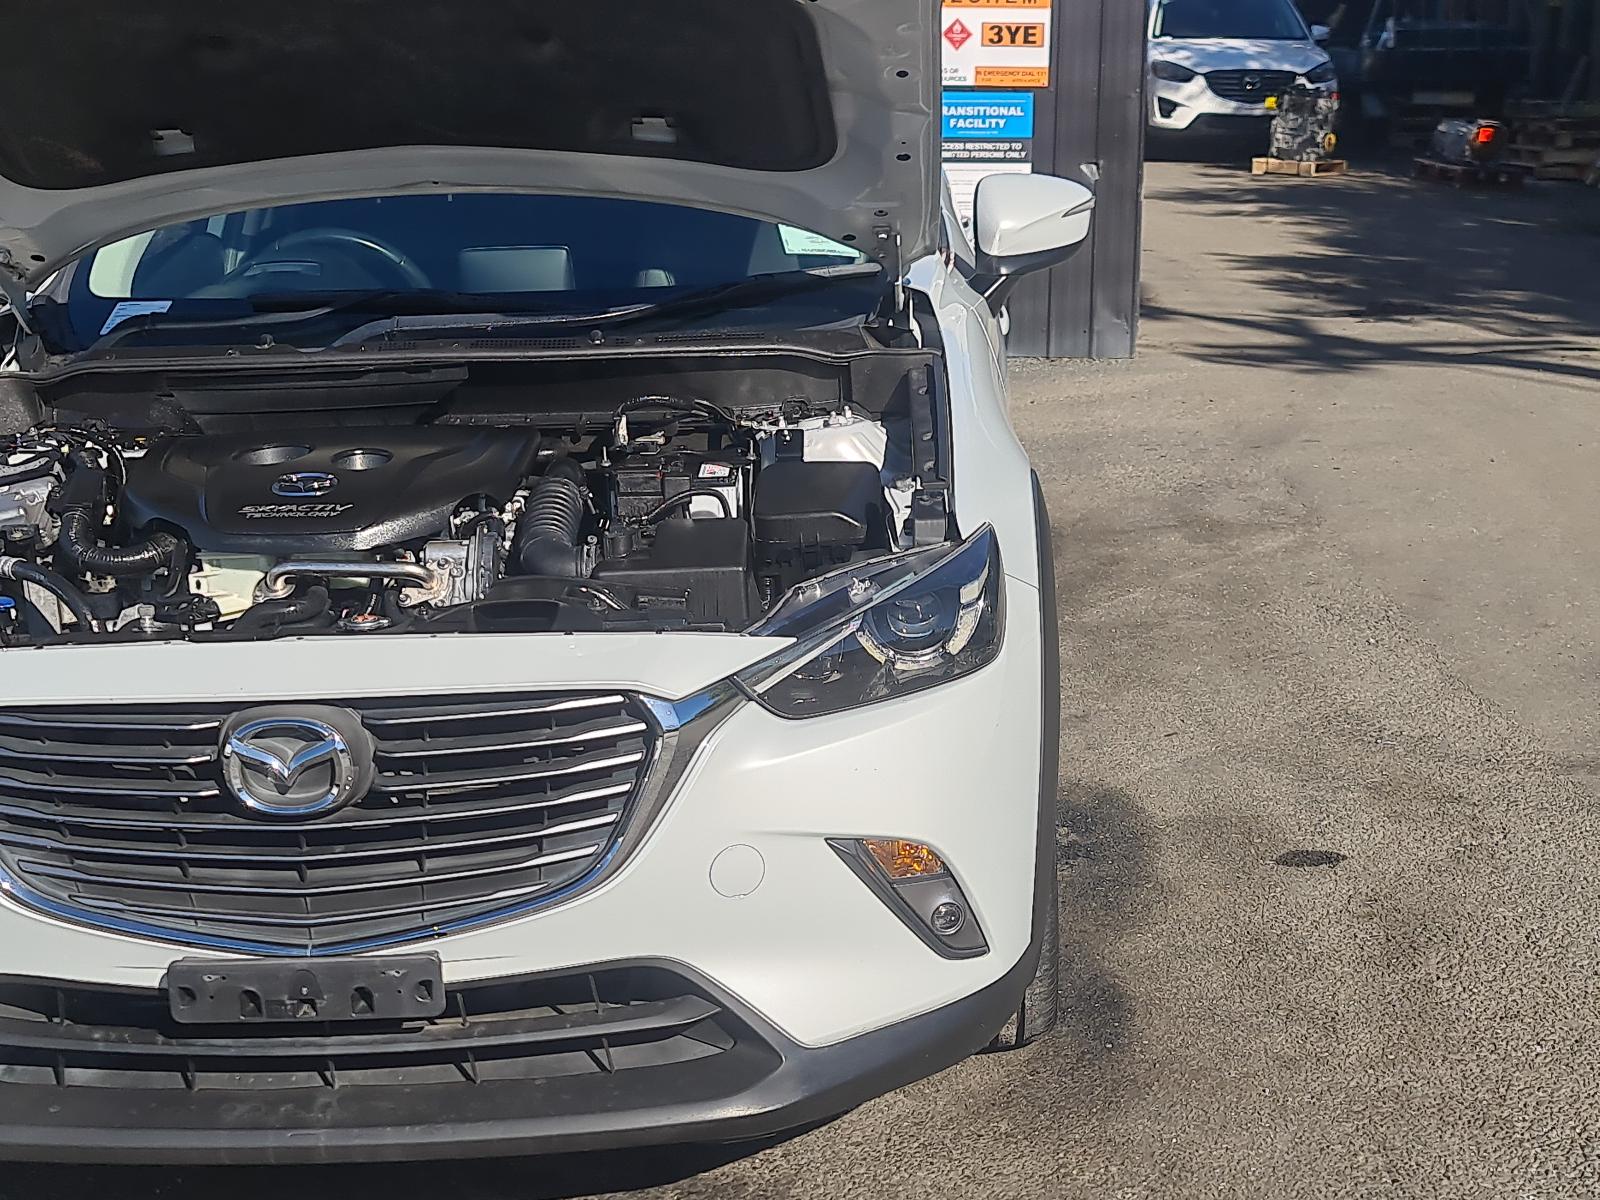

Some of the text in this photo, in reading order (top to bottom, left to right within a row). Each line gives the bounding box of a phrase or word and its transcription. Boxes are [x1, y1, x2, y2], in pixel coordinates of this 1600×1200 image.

[988, 25, 1037, 44] 3YE
[949, 118, 1007, 129] FACILITY
[965, 142, 1010, 151] RESTRICTED
[1011, 142, 1023, 151] TO
[1005, 151, 1027, 159] ONLY
